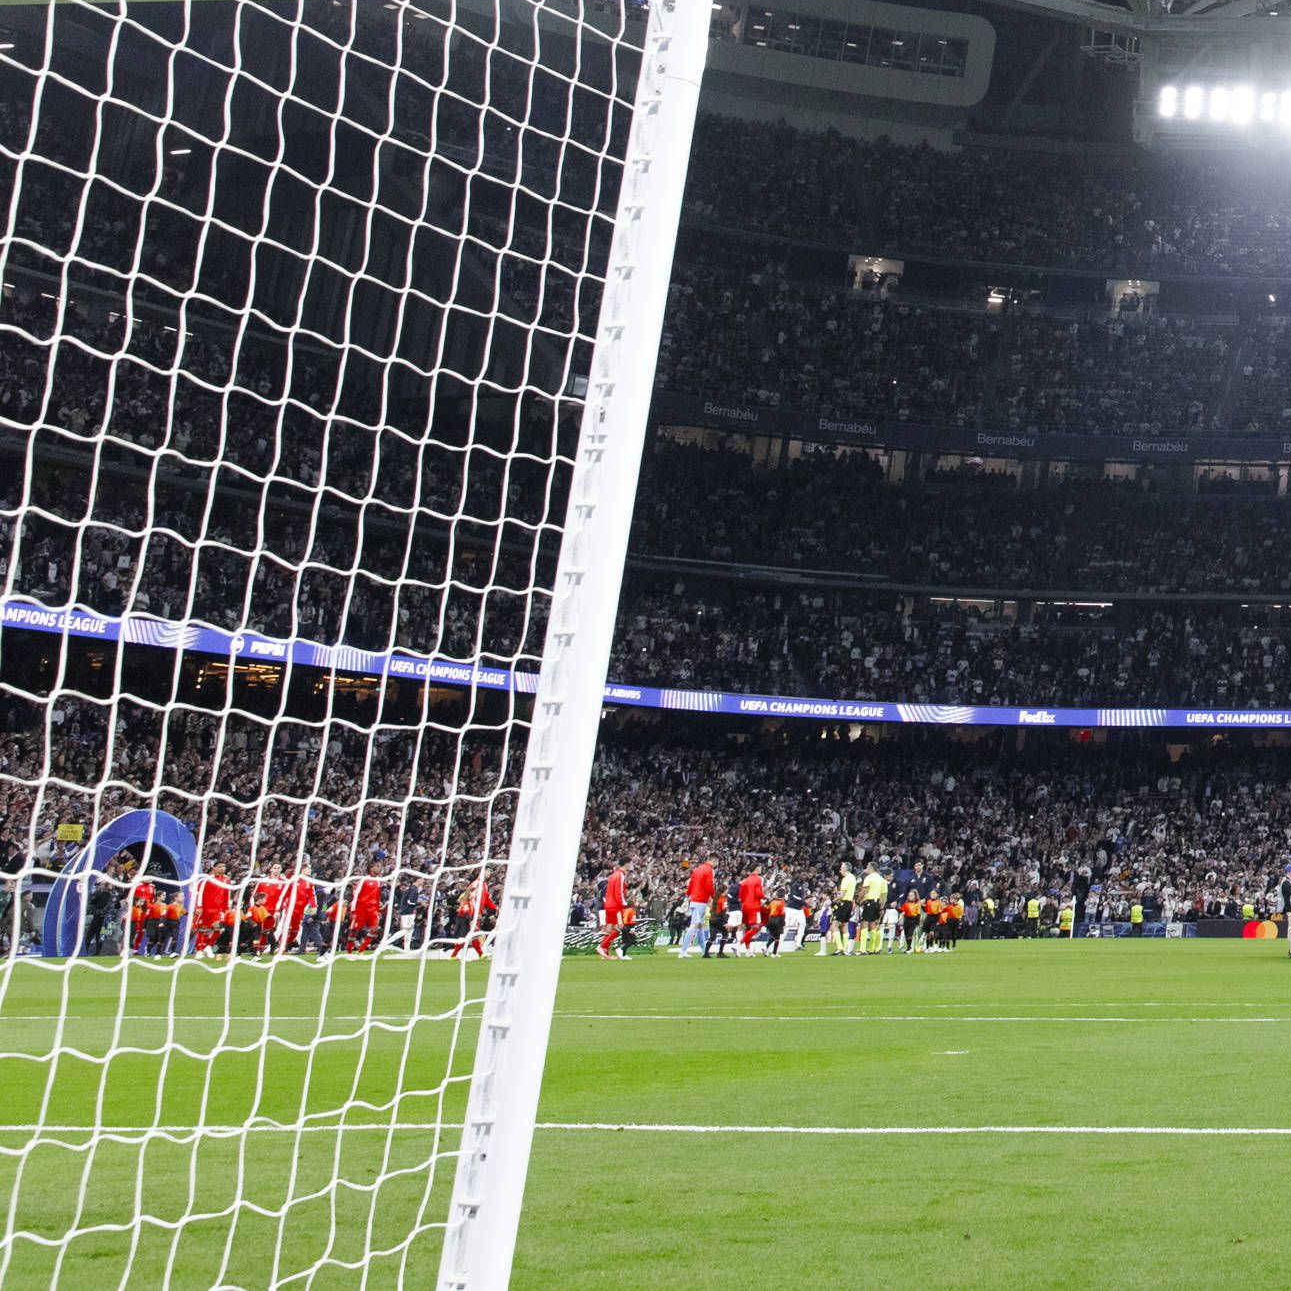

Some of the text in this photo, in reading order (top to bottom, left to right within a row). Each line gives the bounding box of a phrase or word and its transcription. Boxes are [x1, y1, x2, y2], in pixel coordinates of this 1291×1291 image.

[703, 402, 759, 422] Bernabéu
[818, 417, 877, 435] Bernabéu
[977, 432, 1036, 448] Bernabéu
[1132, 439, 1189, 453] Bernabéu
[250, 641, 286, 658] PEPSI
[391, 660, 415, 674] UEFA
[416, 663, 471, 681] CHAMPIONS
[740, 700, 885, 718] UEFA CHAMPIONS LEAGUE
[1019, 710, 1056, 724] FedEx
[1186, 713, 1215, 724] UEFA
[1216, 713, 1283, 724] CHAMPIONS
